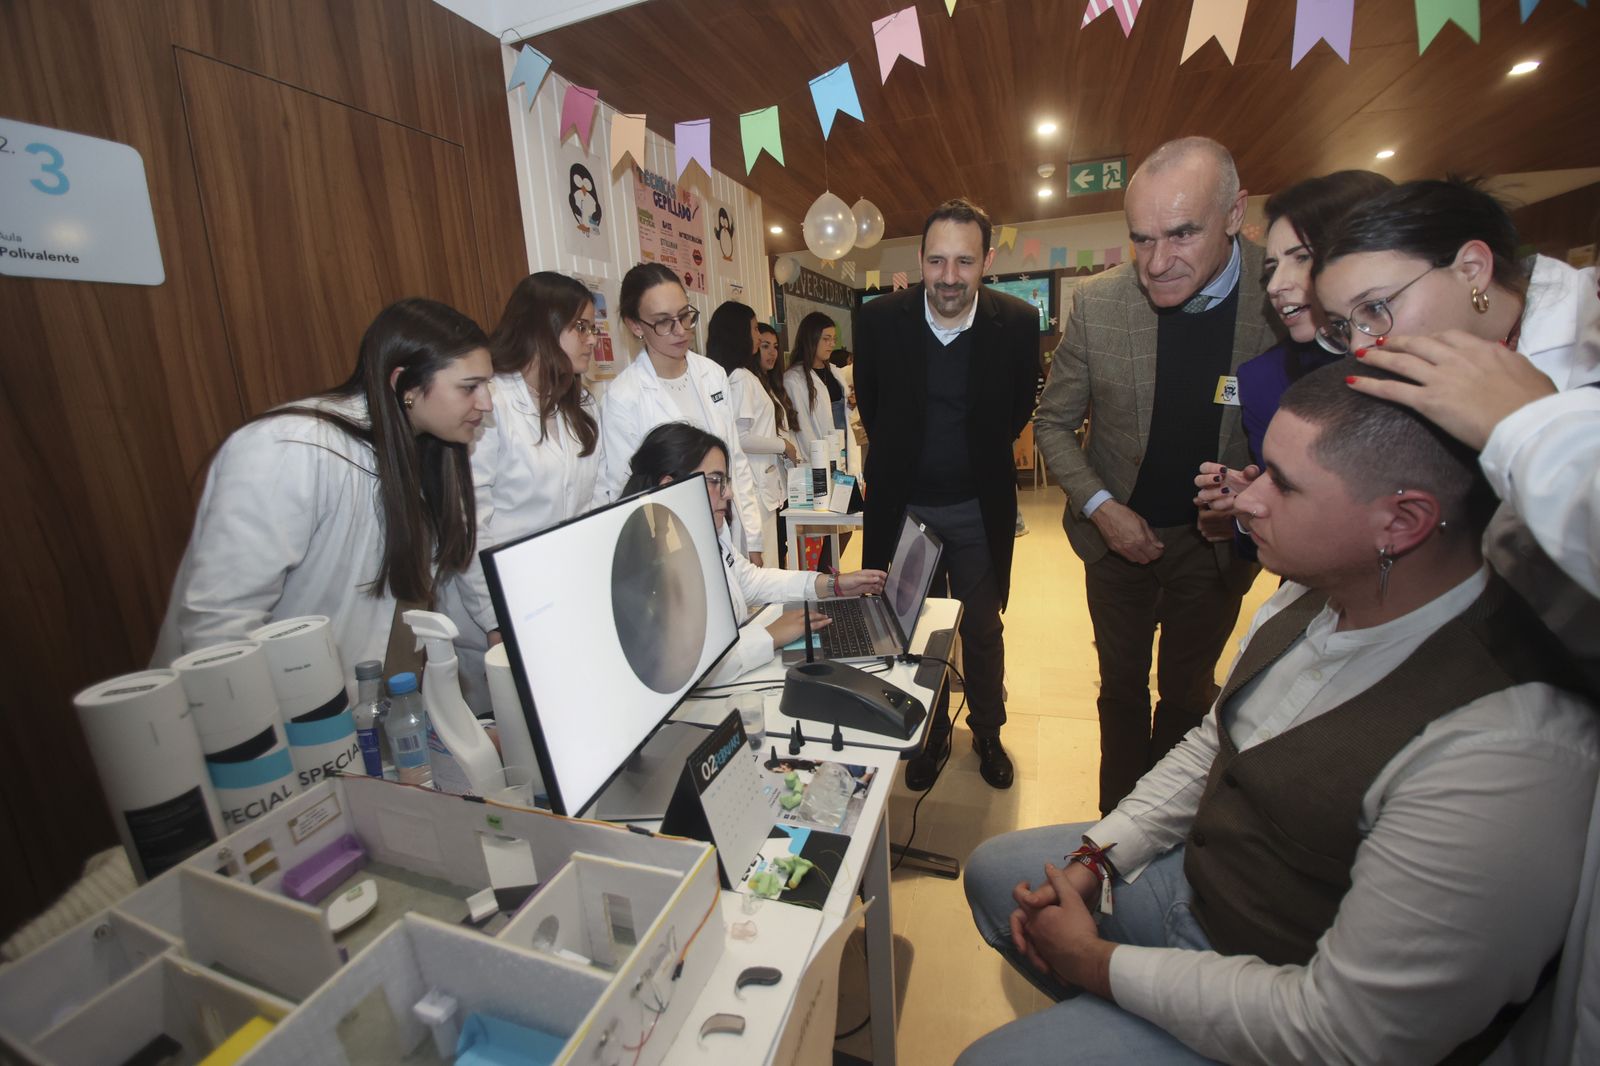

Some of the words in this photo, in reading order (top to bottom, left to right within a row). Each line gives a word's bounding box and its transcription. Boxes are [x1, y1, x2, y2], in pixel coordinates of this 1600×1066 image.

[25, 142, 70, 195] 3
[653, 190, 692, 221] CEPILLADO
[0, 246, 79, 264] Polivalente
